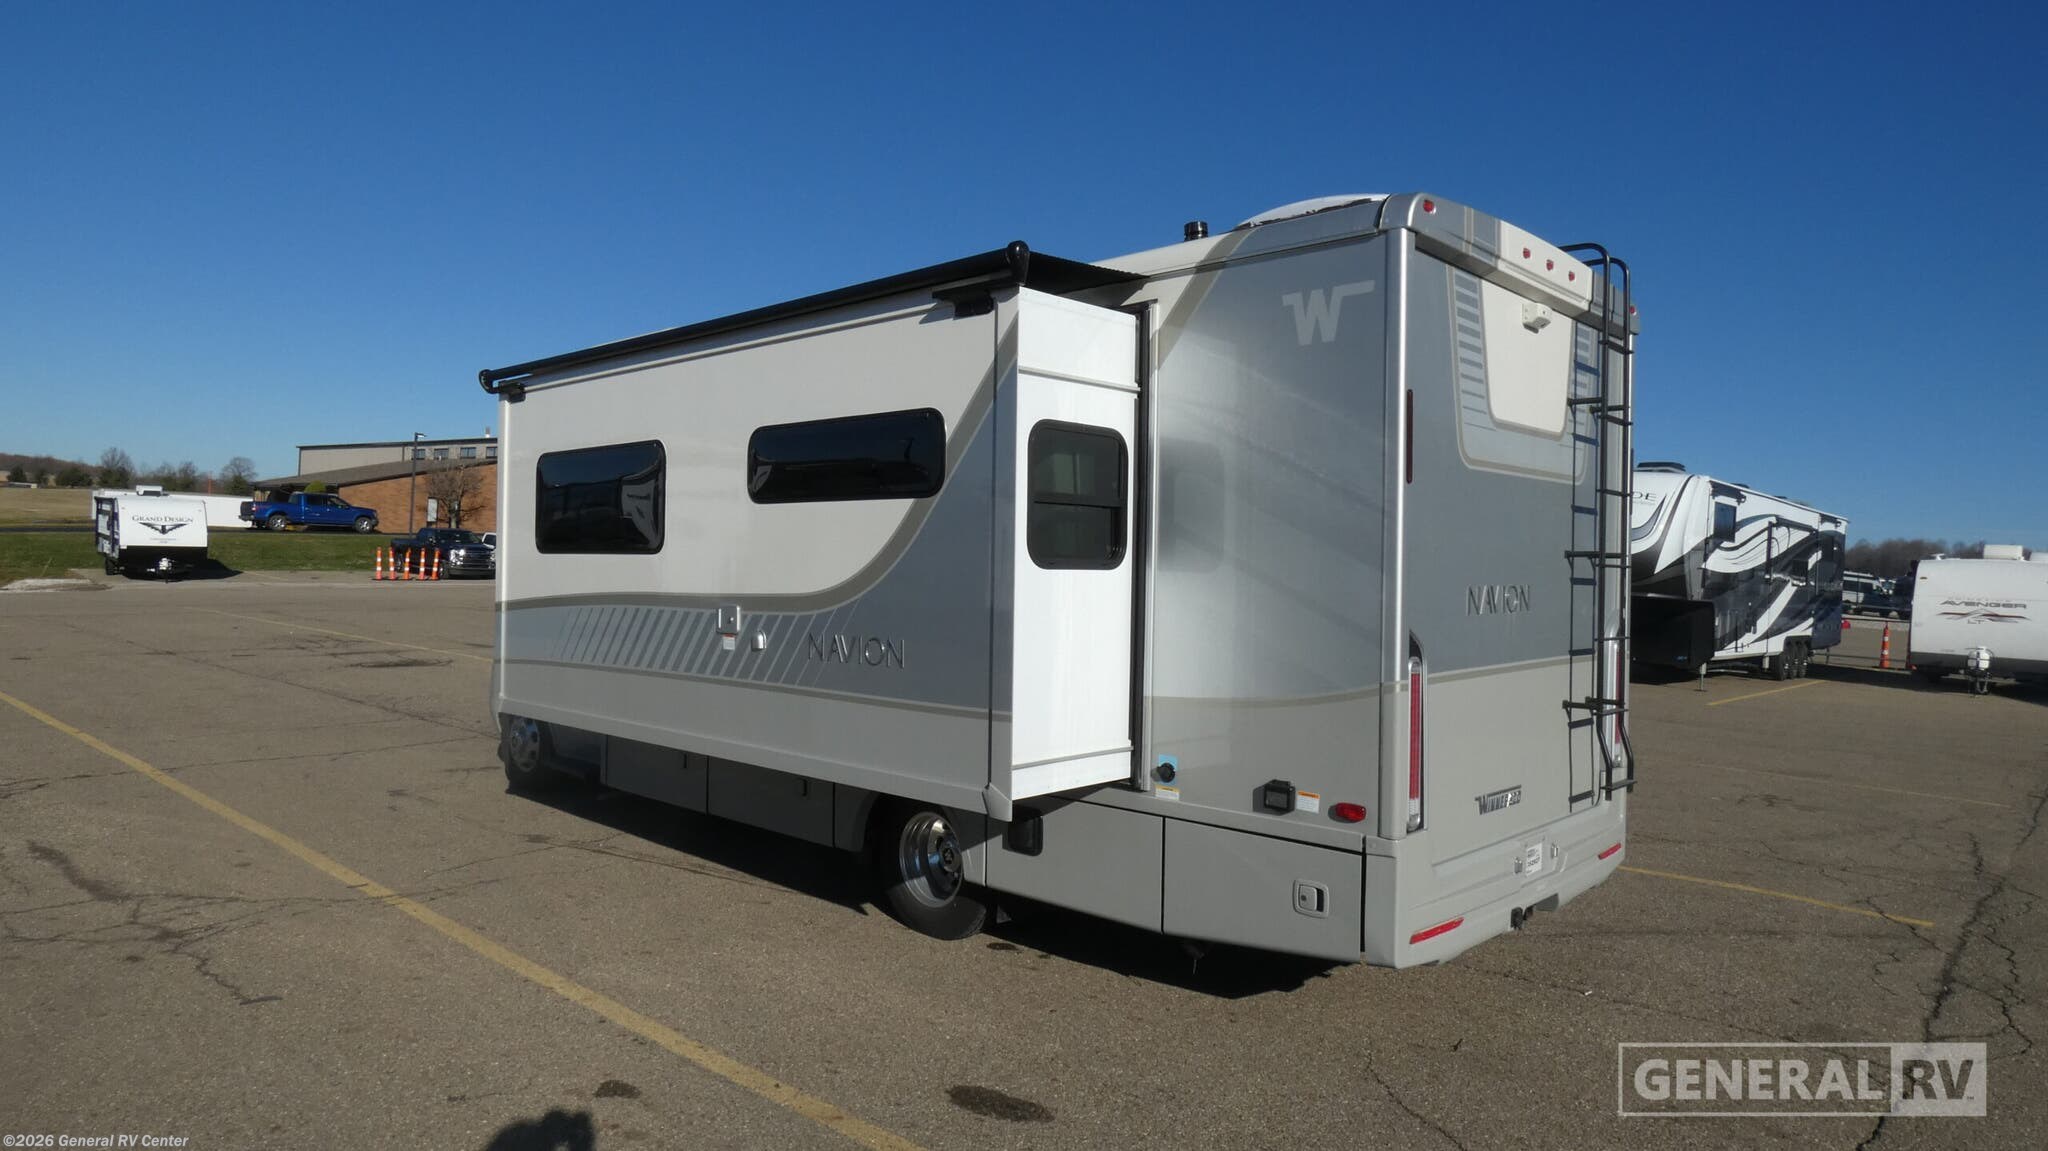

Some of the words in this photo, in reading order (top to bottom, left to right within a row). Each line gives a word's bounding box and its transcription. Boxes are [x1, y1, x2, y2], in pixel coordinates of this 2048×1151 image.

[1465, 585, 1530, 615] NAVION
[1940, 600, 2027, 609] AVENGER
[808, 632, 905, 669] NAVION
